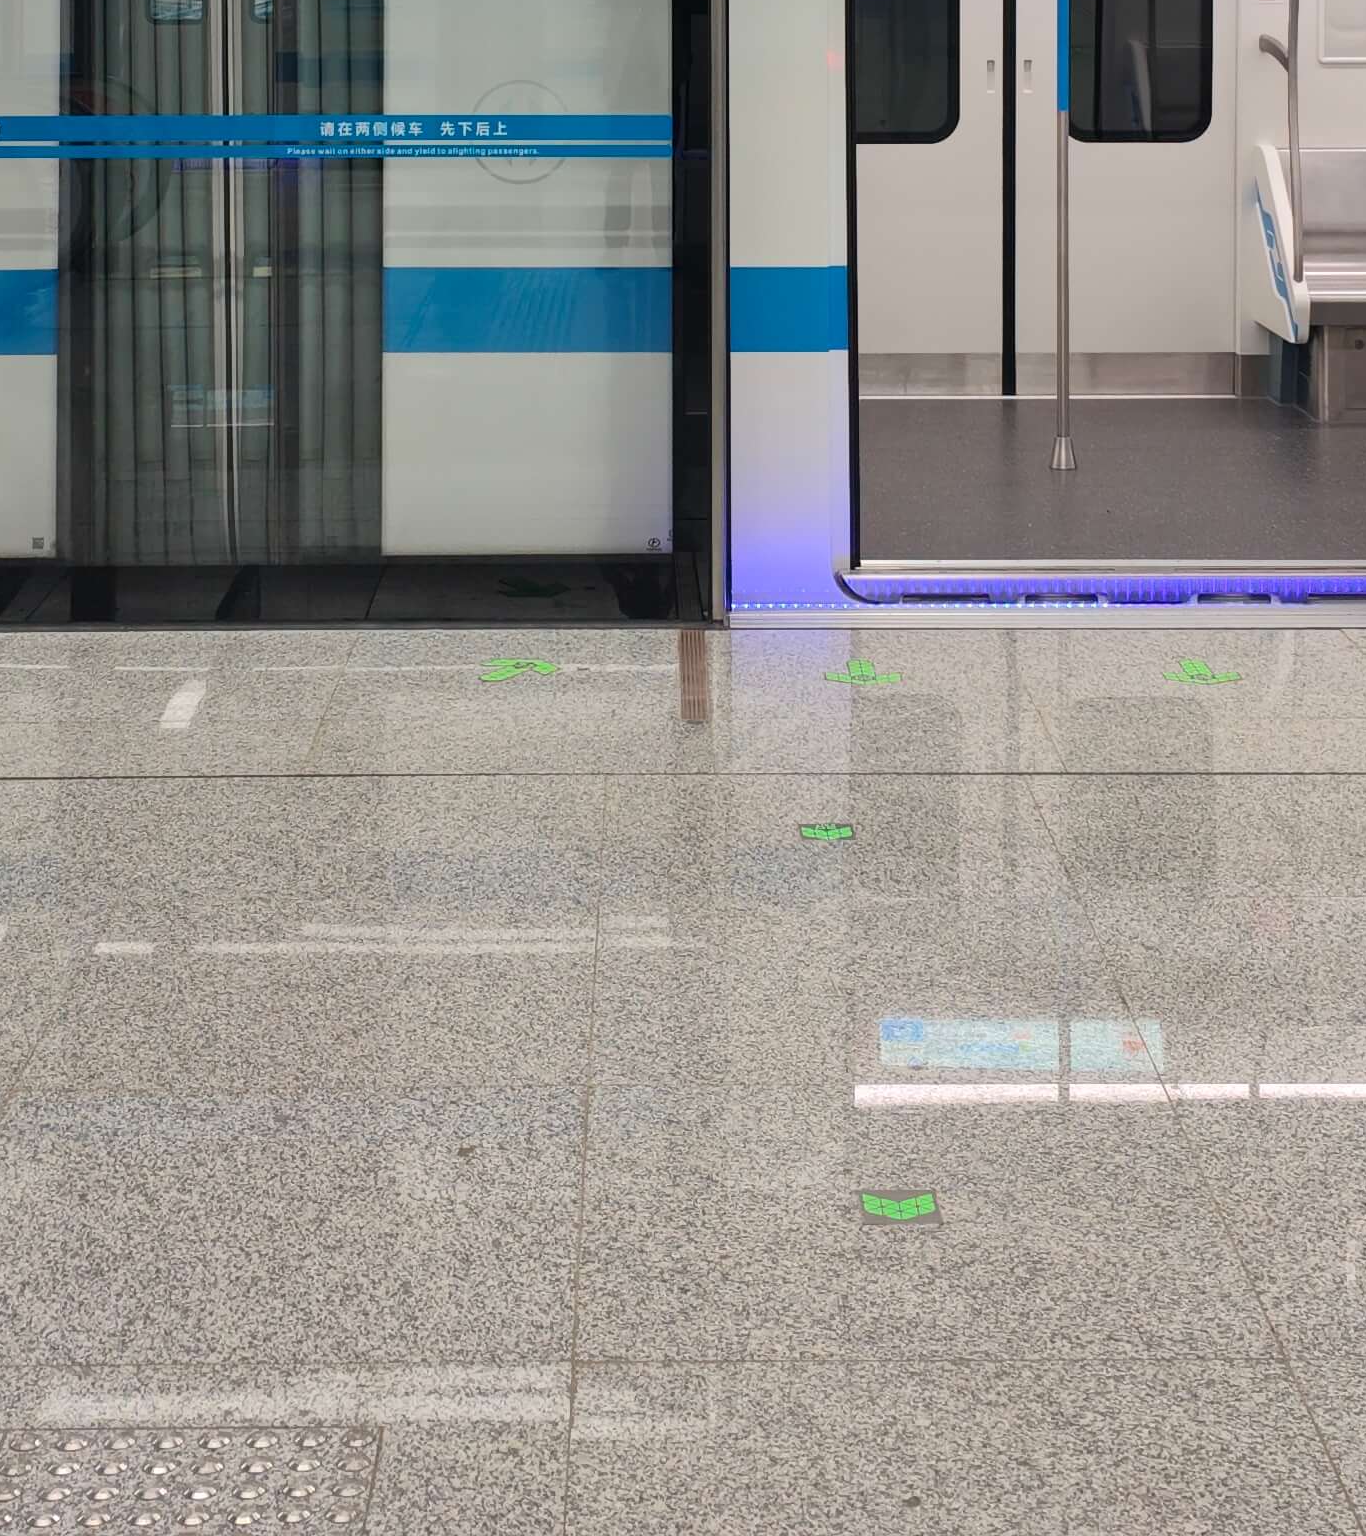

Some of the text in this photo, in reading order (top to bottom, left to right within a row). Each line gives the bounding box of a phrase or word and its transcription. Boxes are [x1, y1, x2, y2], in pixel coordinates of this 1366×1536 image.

[320, 121, 508, 137] 请在两侧候车 先下后上
[396, 147, 412, 156] and
